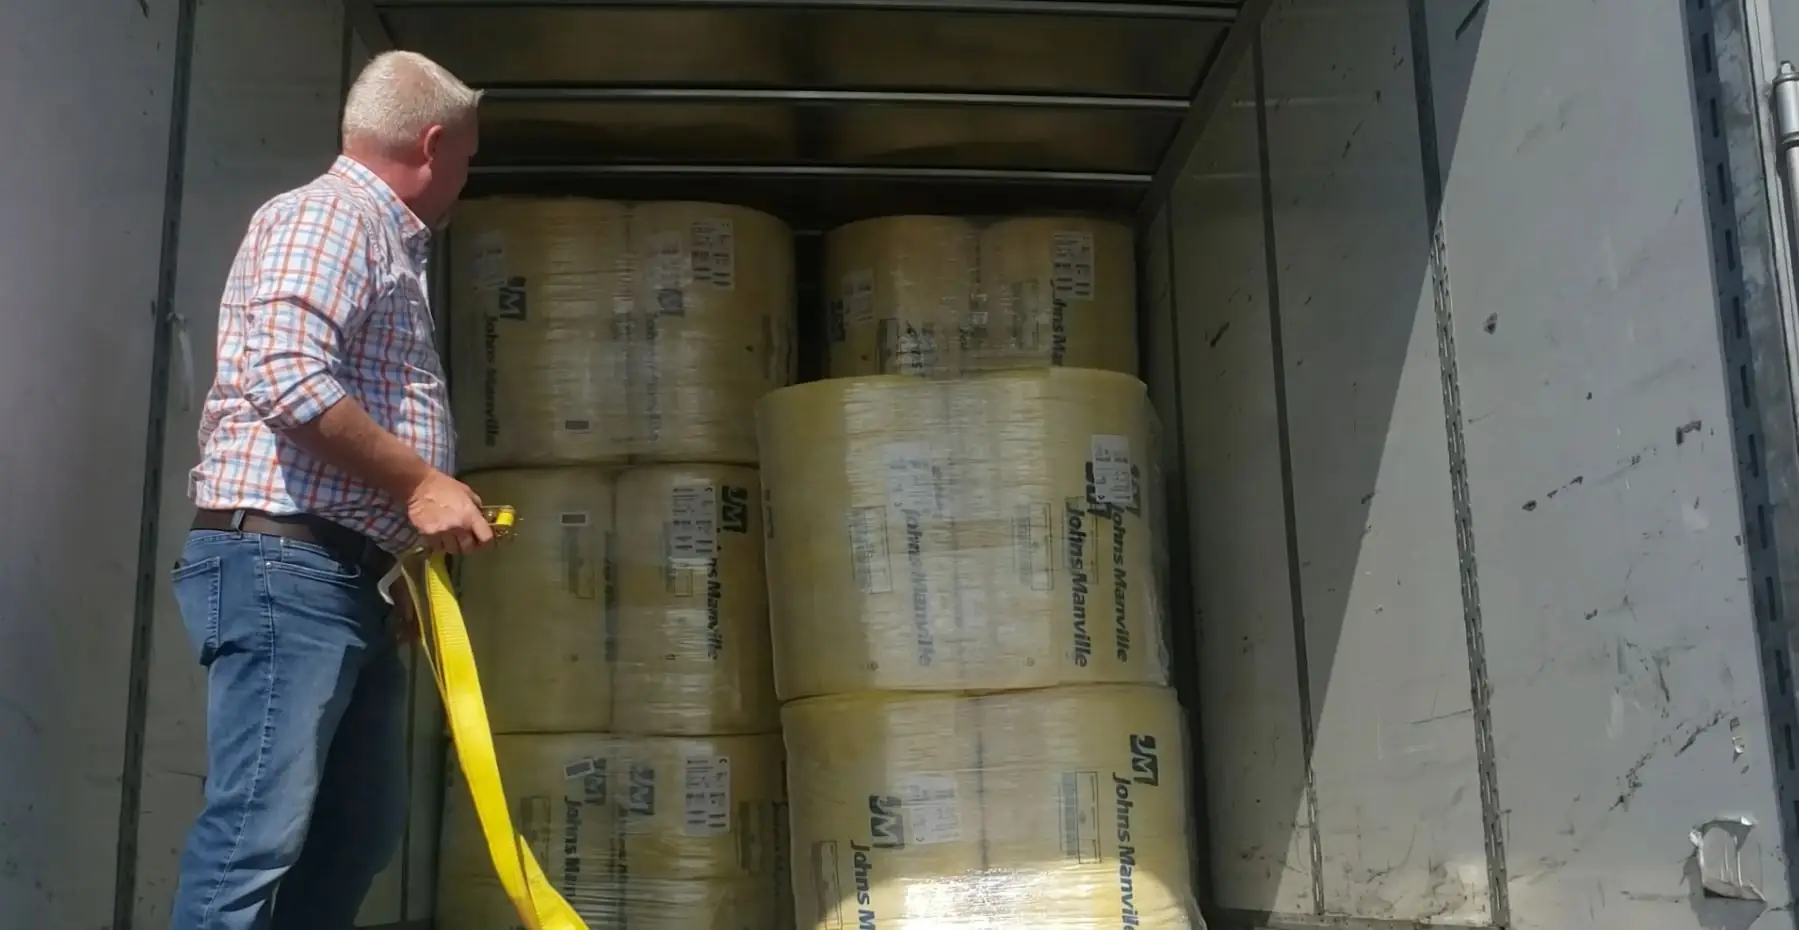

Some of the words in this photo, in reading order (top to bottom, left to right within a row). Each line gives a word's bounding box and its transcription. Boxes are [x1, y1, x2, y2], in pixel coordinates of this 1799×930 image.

[721, 486, 749, 534] JM
[1066, 503, 1087, 569] Johns
[910, 571, 936, 667] Manville
[1070, 570, 1092, 668] Manville
[1112, 567, 1131, 664] Manville
[1130, 734, 1159, 787] JM
[563, 796, 584, 854] Johns
[869, 795, 905, 850] JM
[1112, 771, 1135, 842] Johns
[849, 838, 874, 905] Johns
